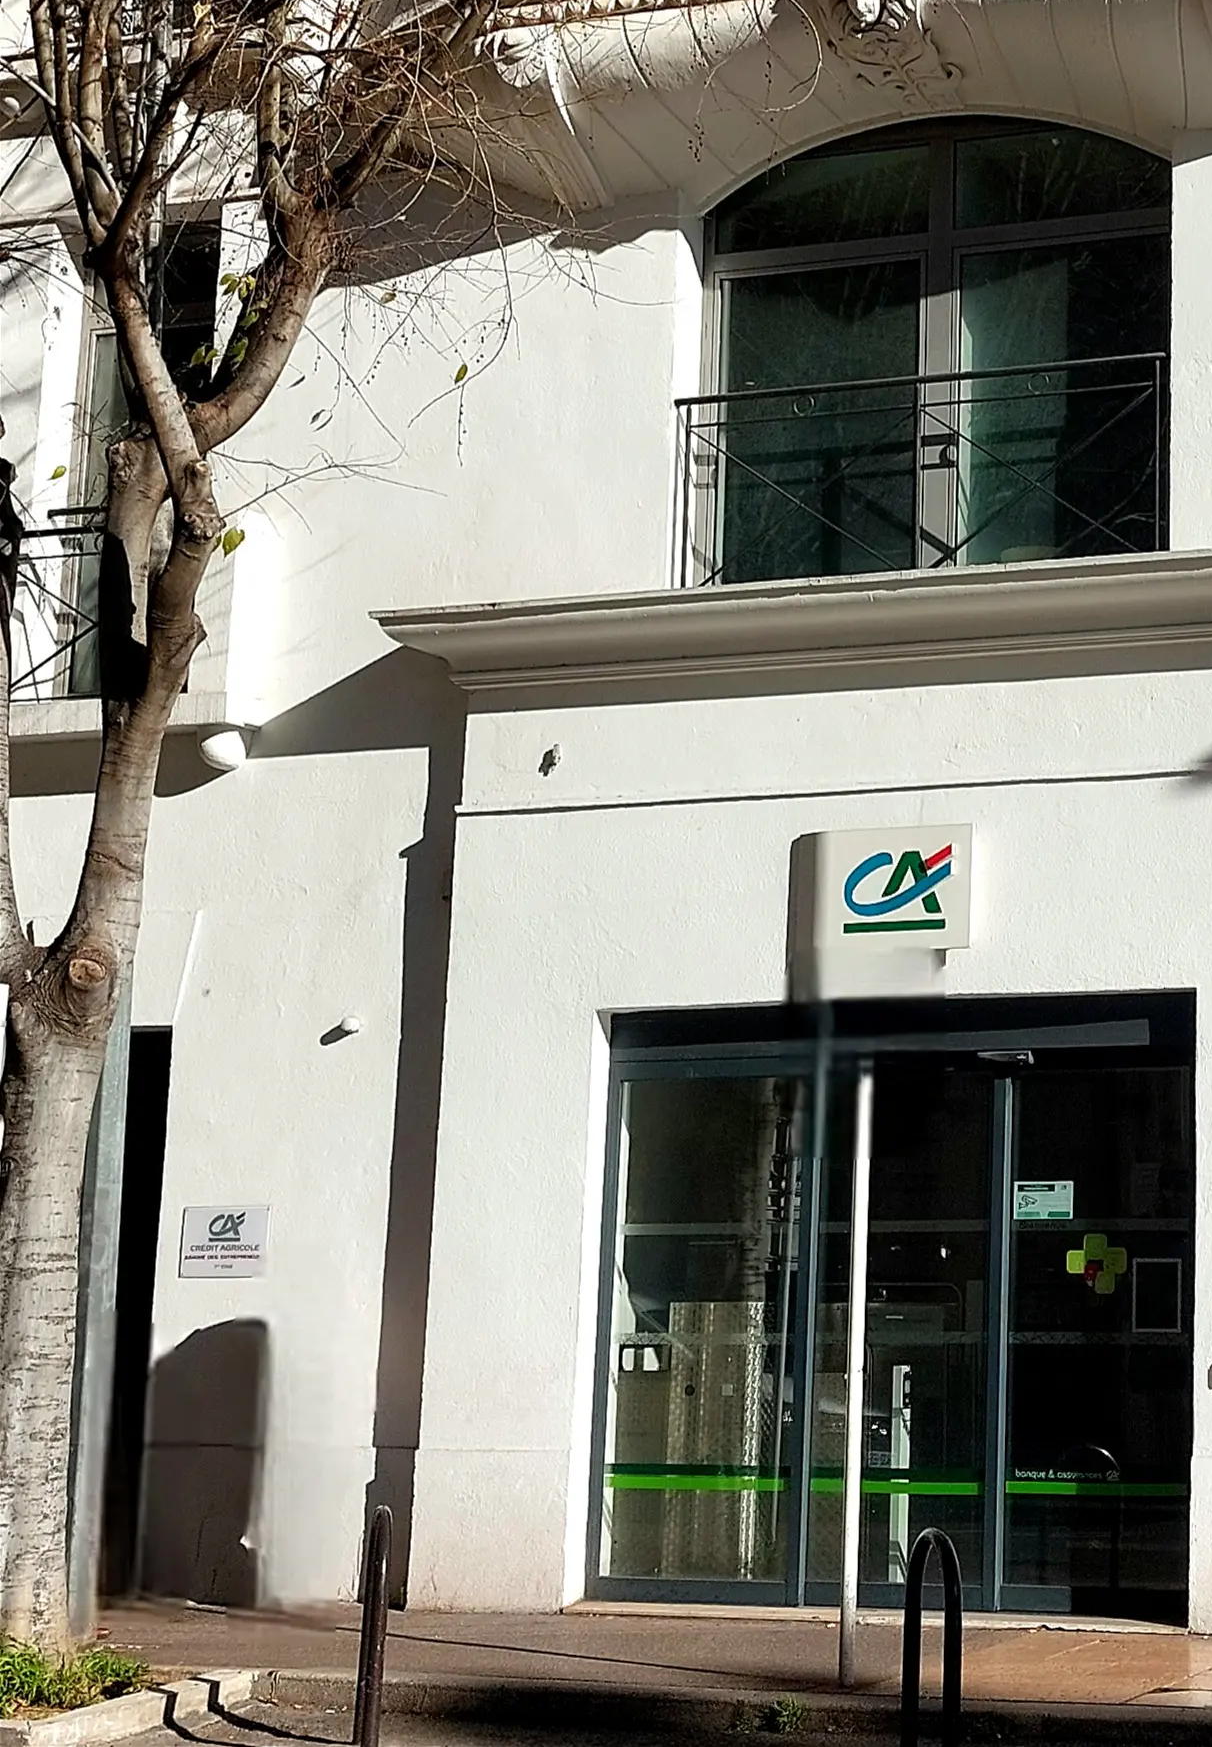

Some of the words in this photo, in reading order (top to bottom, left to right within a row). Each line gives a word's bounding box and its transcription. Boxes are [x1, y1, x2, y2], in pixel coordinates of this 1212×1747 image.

[220, 1243, 261, 1252] AGRICOLE
[1015, 1468, 1046, 1480] banque
[1047, 1469, 1055, 1479] &
